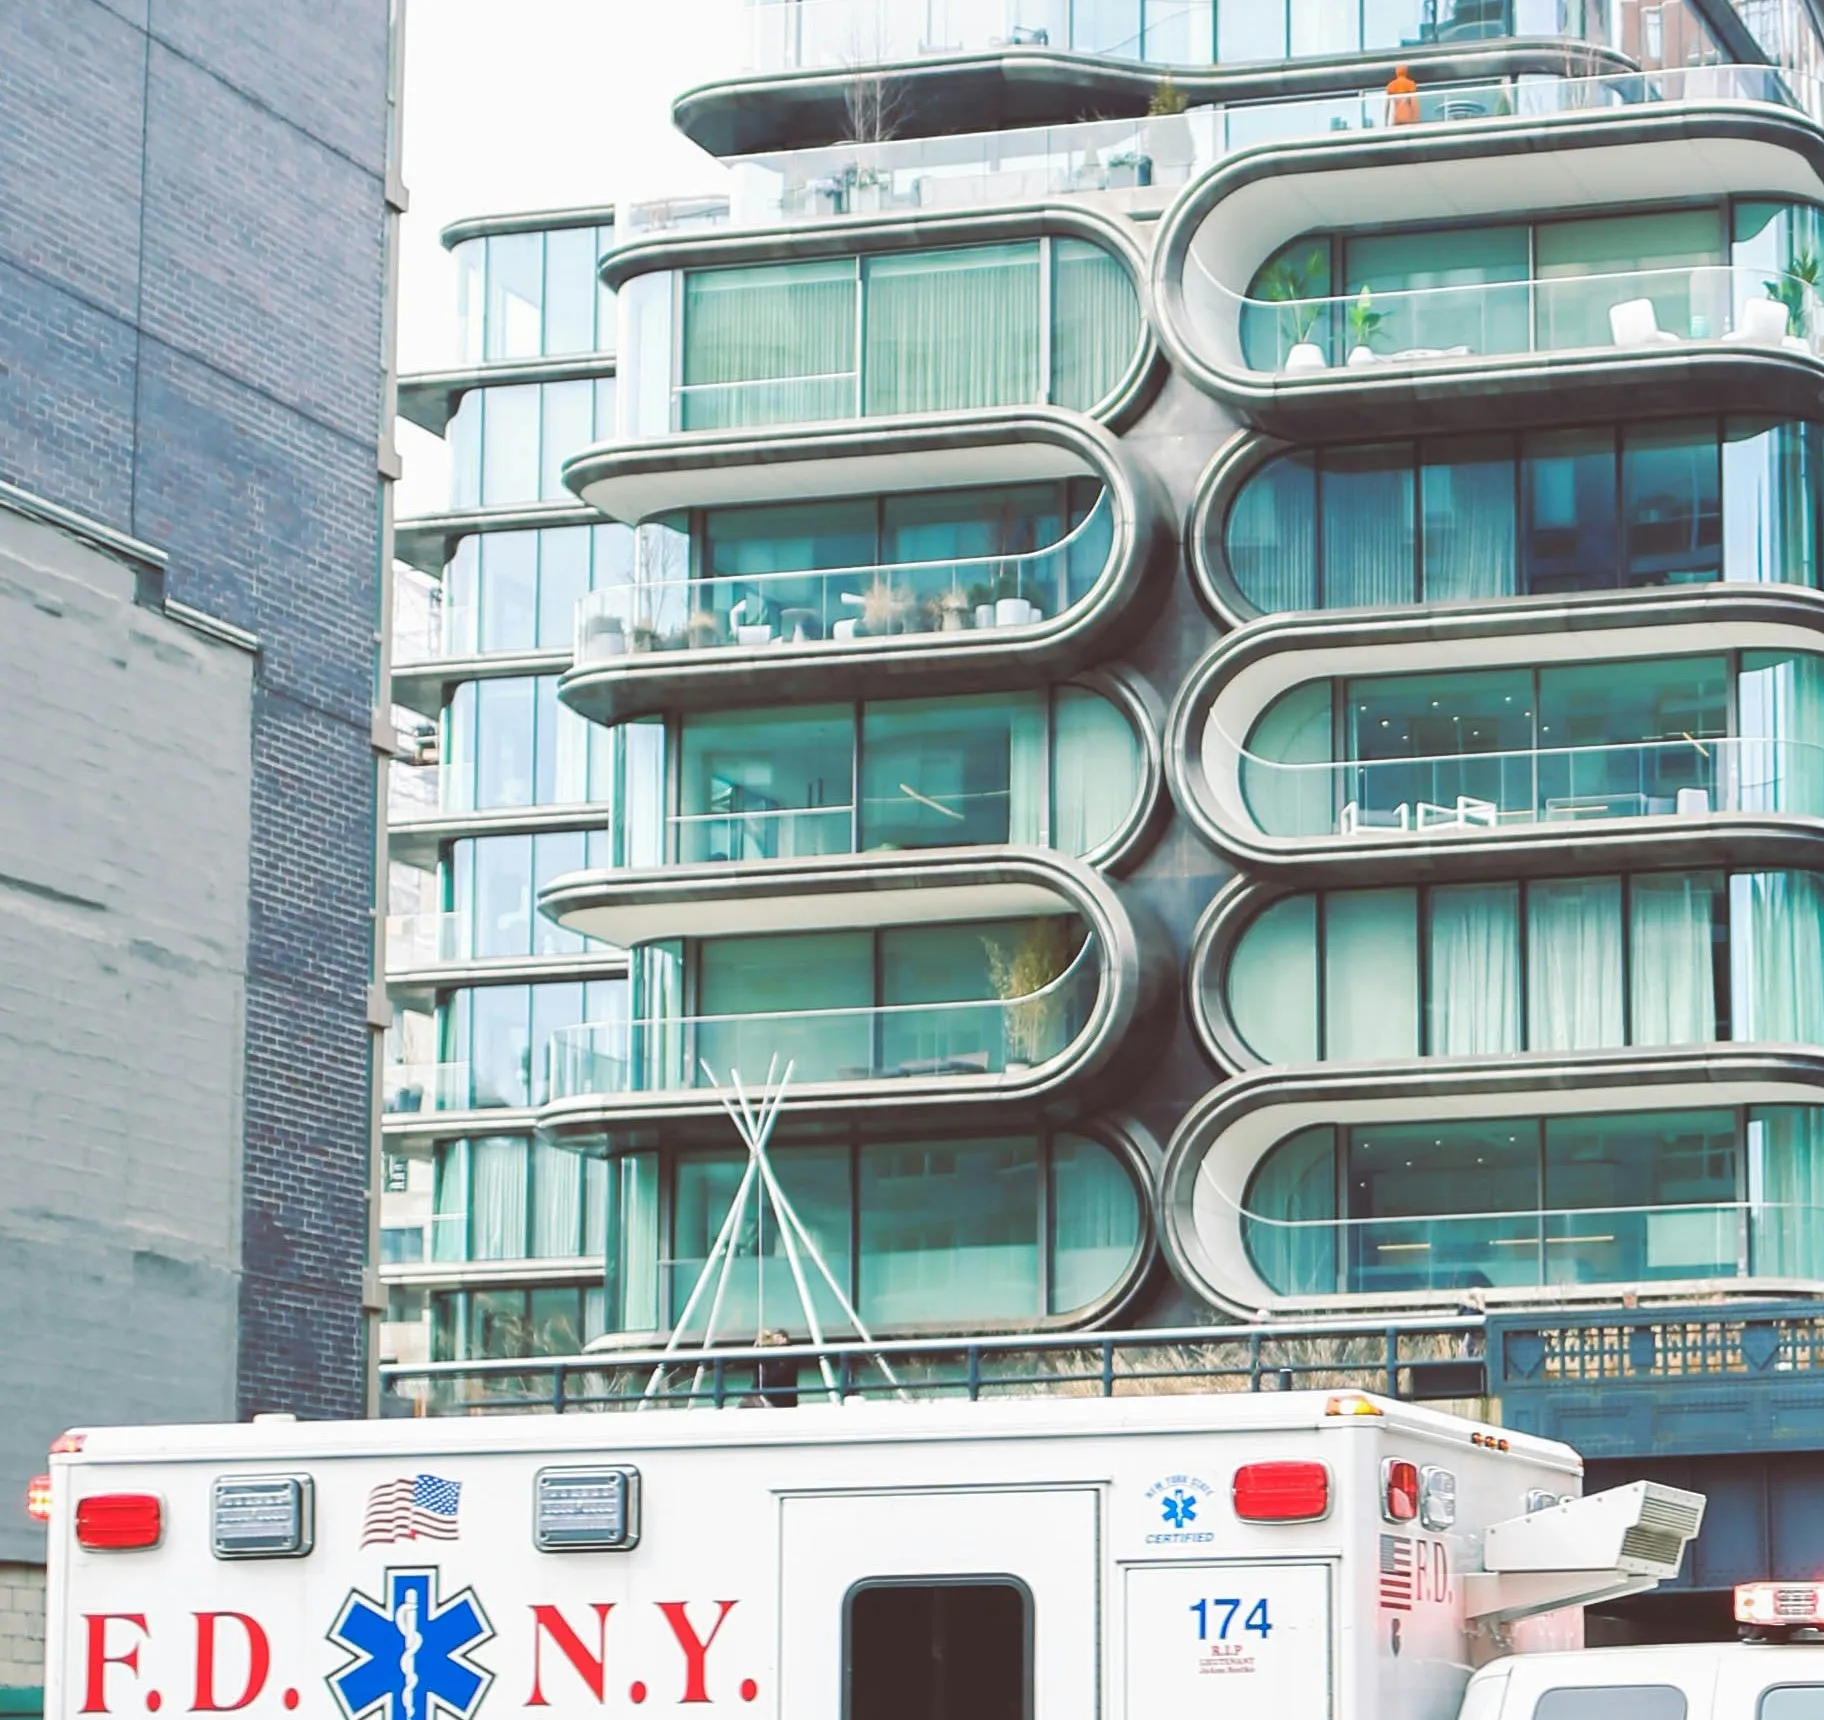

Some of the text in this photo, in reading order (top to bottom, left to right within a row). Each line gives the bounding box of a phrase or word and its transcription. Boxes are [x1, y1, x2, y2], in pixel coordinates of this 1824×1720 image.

[1144, 1532, 1215, 1544] CERTIFIED
[1190, 1598, 1273, 1640] 174
[77, 1600, 759, 1714] F.D. N.Y.
